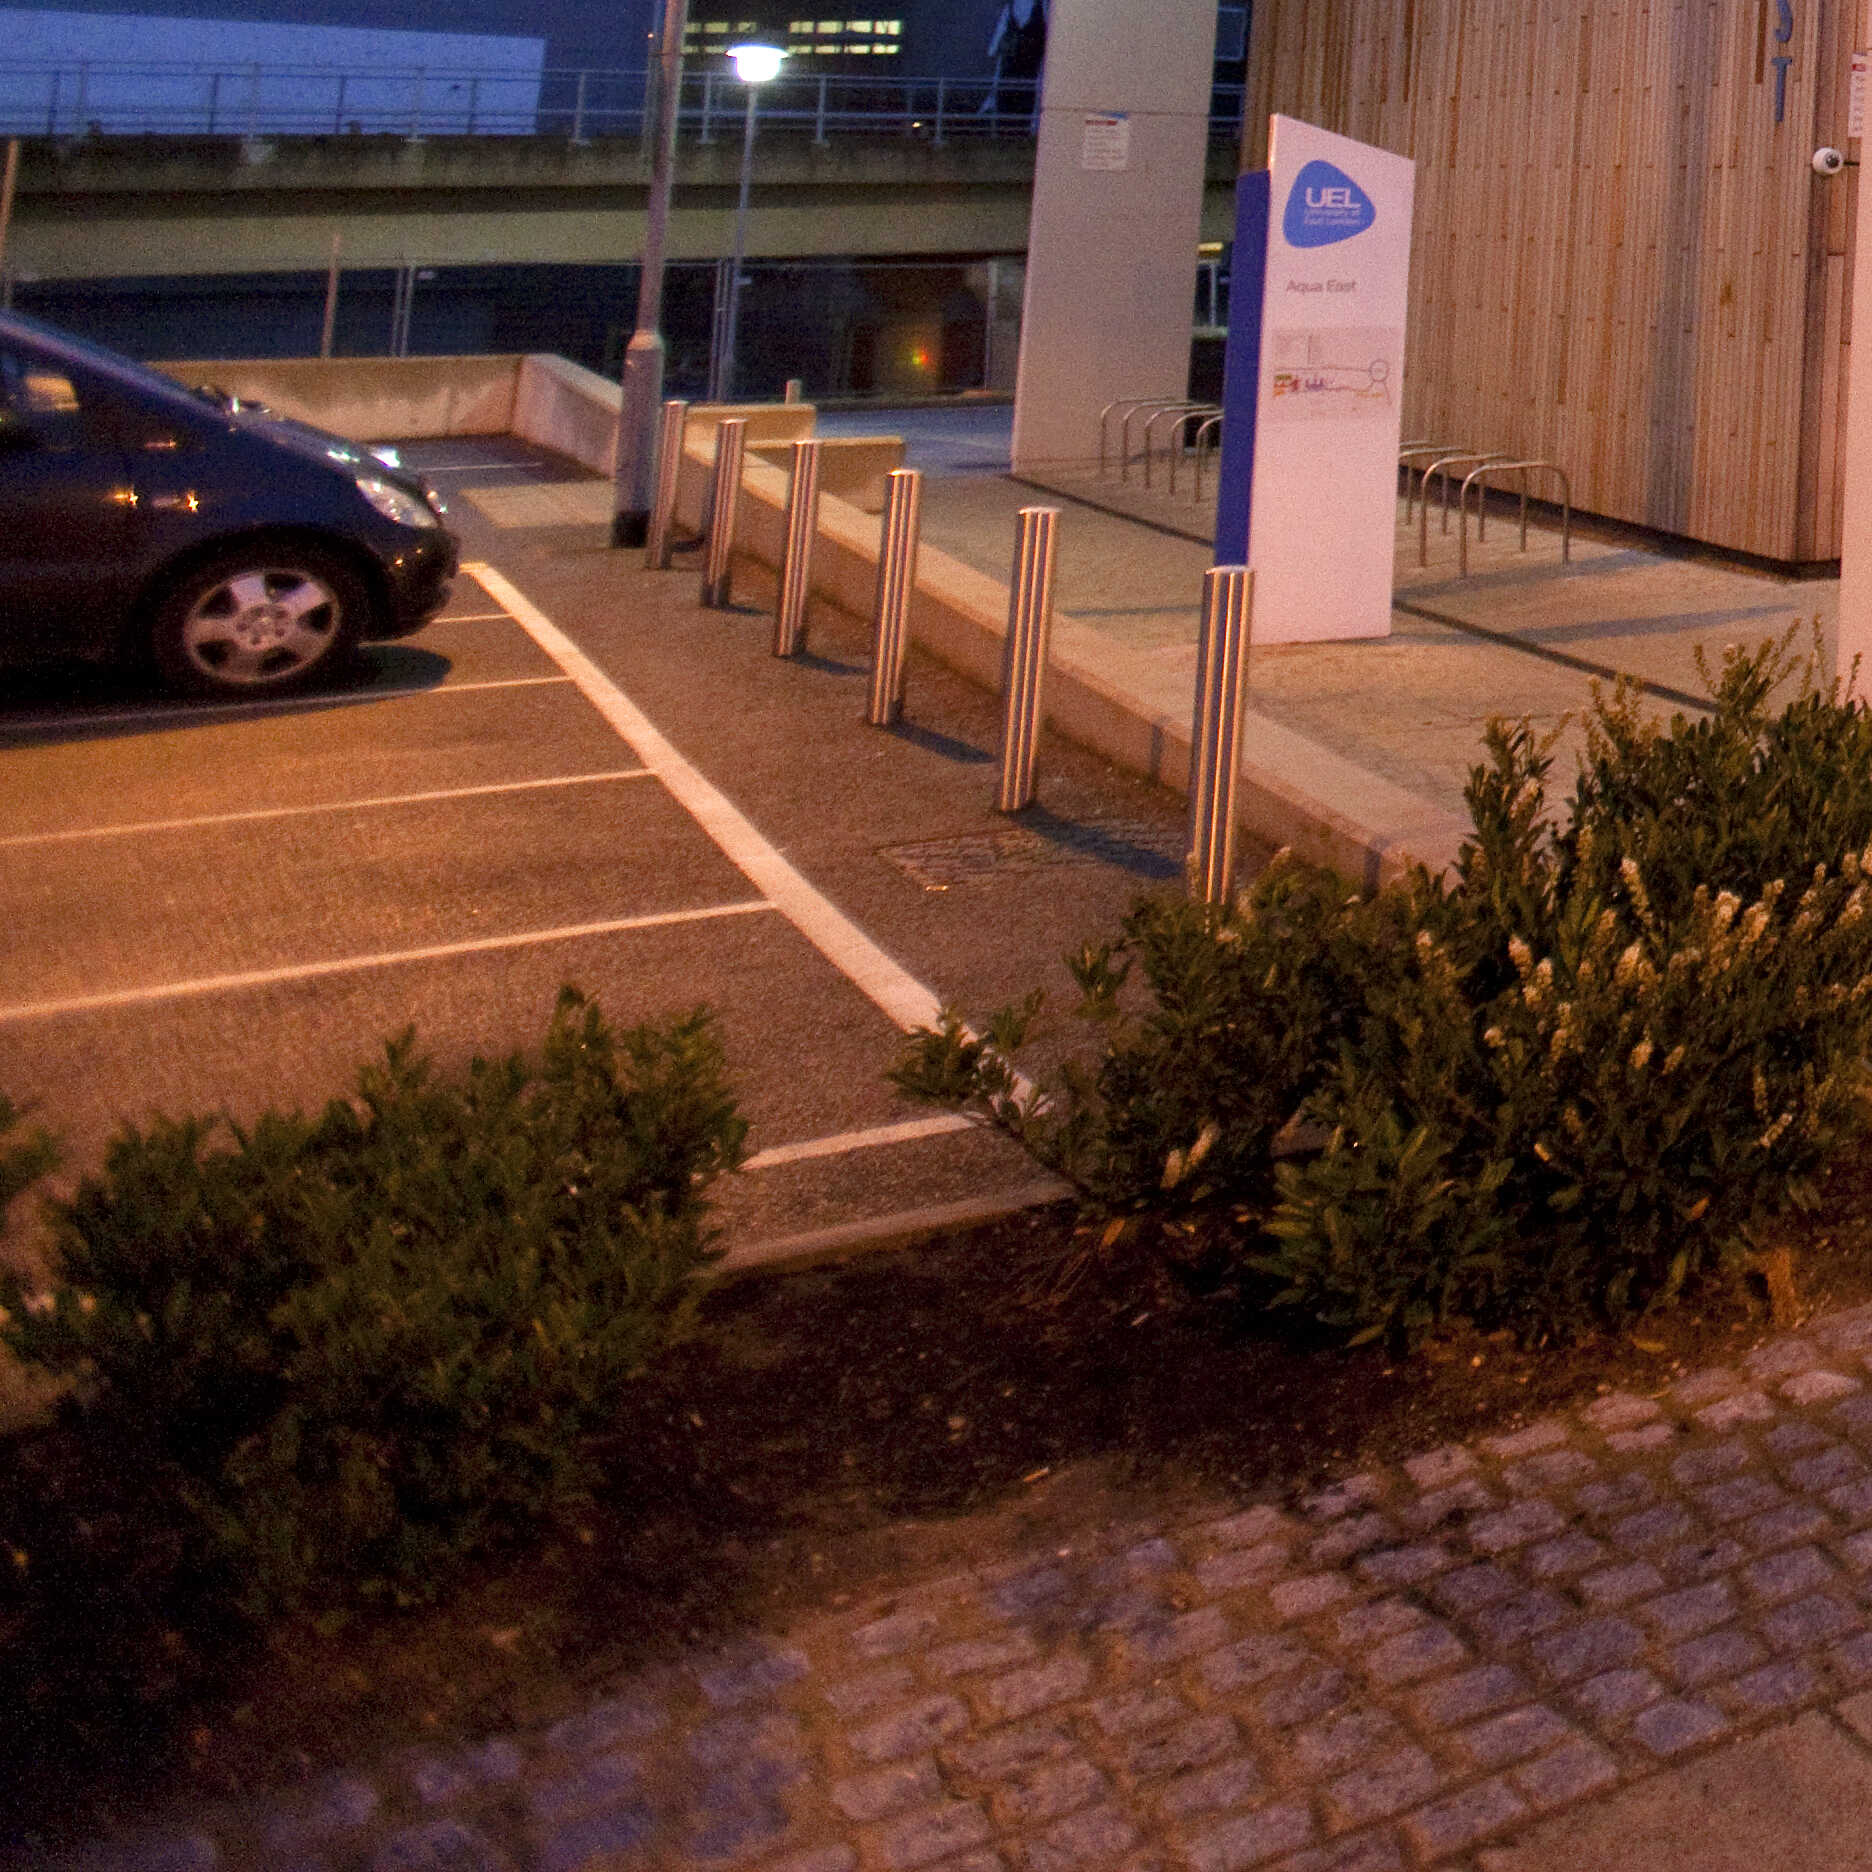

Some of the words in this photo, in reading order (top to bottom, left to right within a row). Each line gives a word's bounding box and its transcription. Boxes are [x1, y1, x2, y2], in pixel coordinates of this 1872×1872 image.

[1305, 187, 1361, 207] UEL
[1286, 280, 1323, 296] Aqua
[1327, 279, 1356, 293] East
